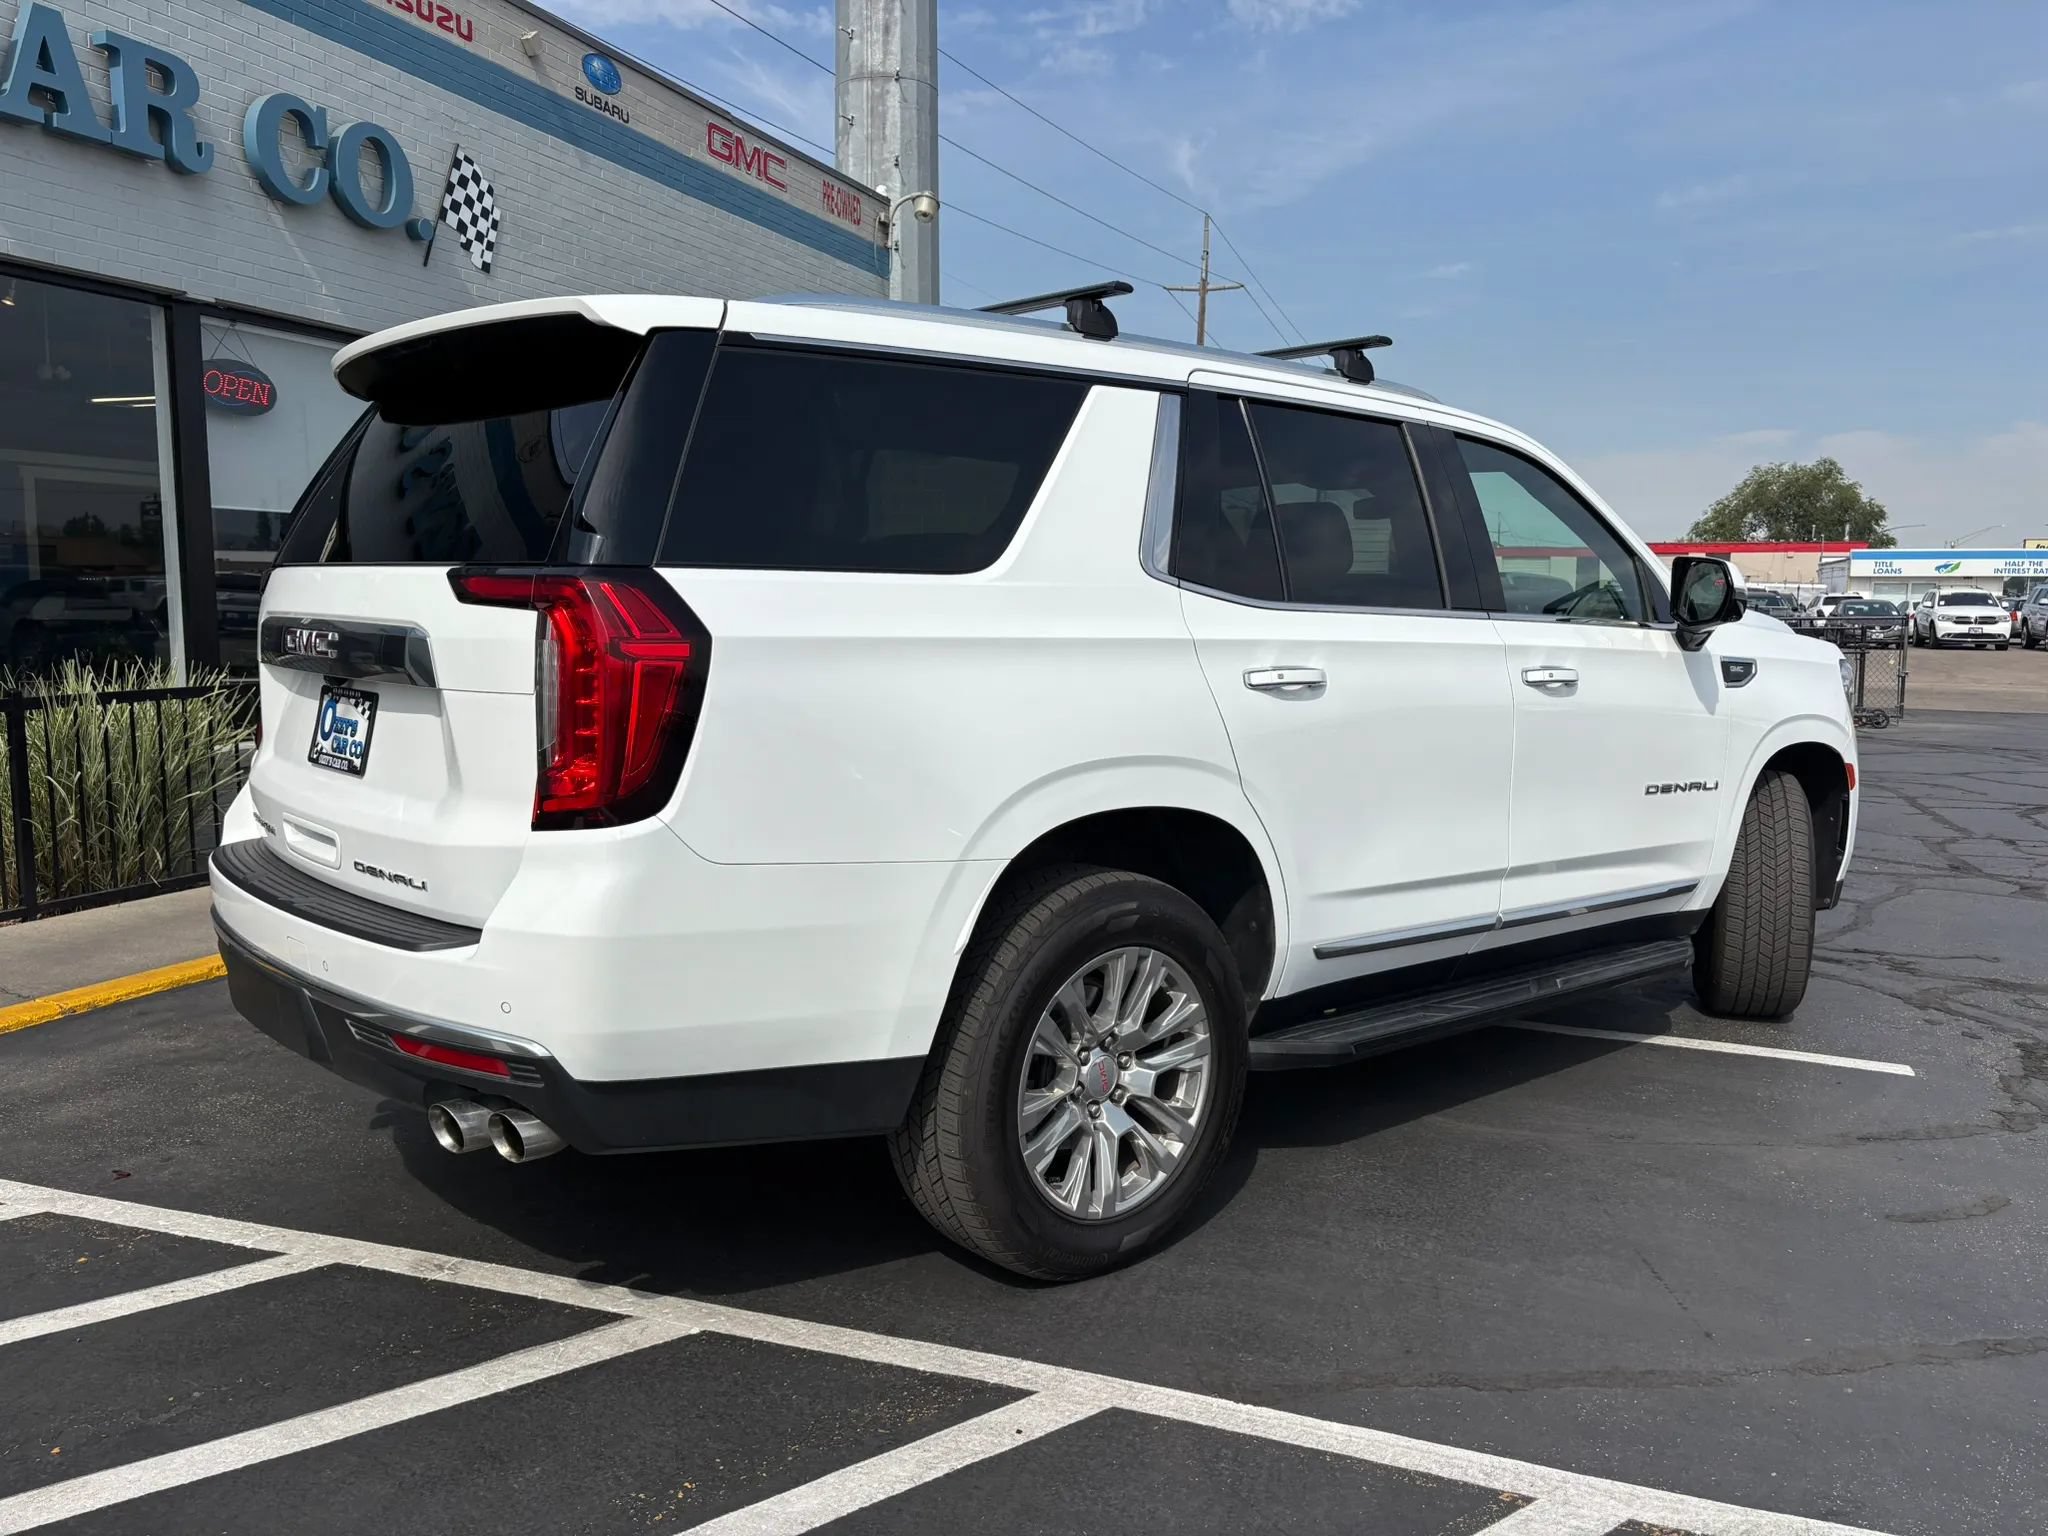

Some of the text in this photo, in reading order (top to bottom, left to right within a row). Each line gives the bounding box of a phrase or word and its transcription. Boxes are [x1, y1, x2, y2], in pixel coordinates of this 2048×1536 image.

[386, 0, 473, 42] UZU
[575, 86, 630, 124] SUBARU
[243, 92, 434, 242] CO.
[707, 121, 787, 193] GMC
[823, 180, 862, 226] PRE-OWNED
[203, 369, 271, 406] OPEN
[284, 627, 339, 659] GMC
[331, 735, 349, 756] CAR
[1644, 780, 1719, 796] DENALI
[353, 860, 428, 893] DENALI
